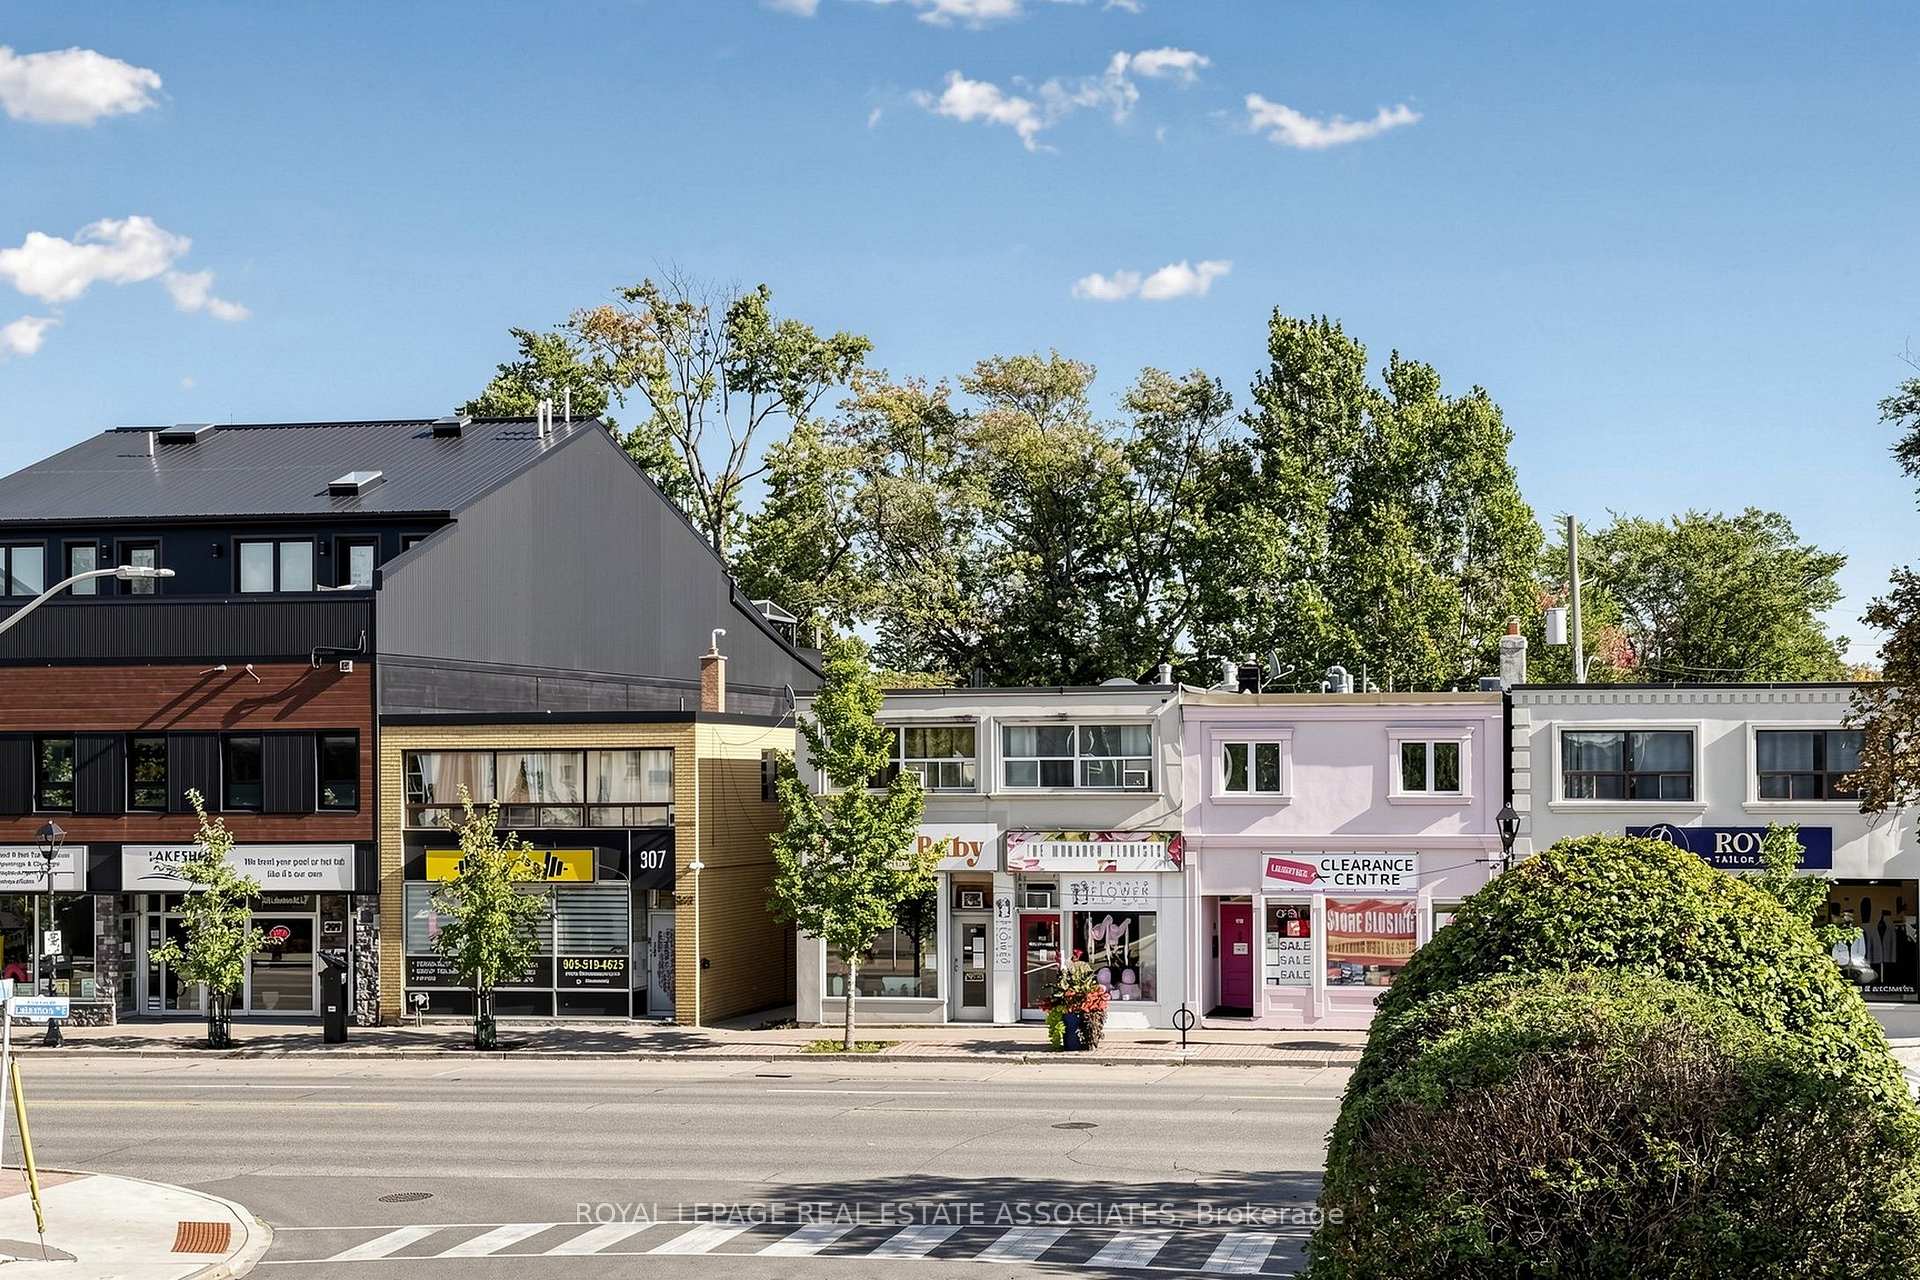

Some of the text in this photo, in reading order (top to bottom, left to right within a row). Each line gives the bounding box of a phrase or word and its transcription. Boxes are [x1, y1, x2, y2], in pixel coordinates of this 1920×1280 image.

[1715, 855, 1755, 864] TAILOR
[1320, 859, 1414, 872] CLEARANCE
[1334, 873, 1401, 886] CENTRE
[1327, 909, 1363, 933] STORE
[1280, 941, 1311, 951] SALE
[1280, 955, 1311, 965] SALE
[1280, 970, 1311, 980] SALE
